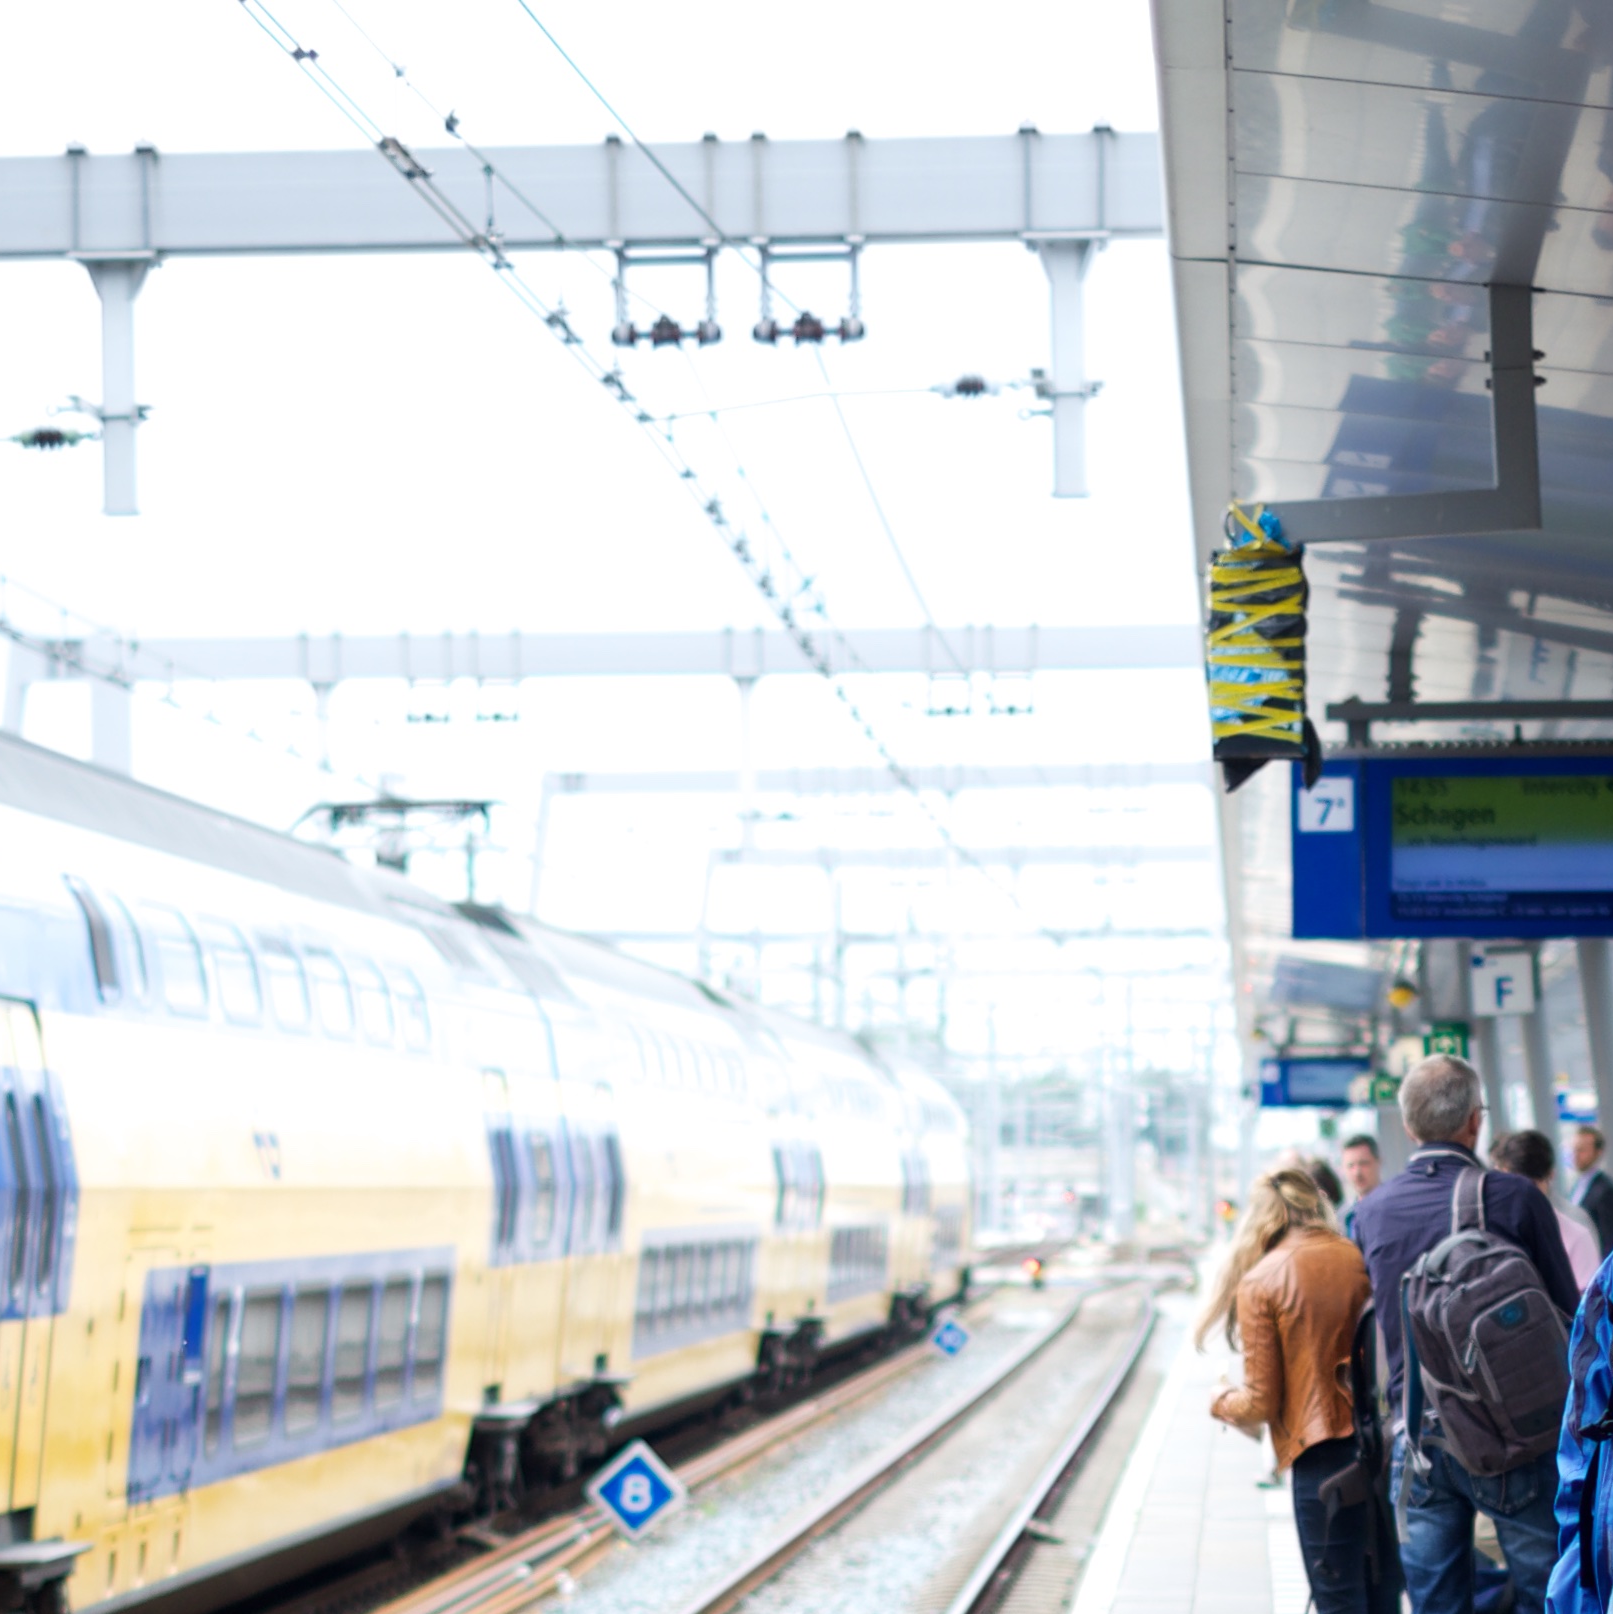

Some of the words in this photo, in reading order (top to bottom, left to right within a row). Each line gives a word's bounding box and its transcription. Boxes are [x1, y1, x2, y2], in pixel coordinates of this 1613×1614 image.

[1395, 803, 1496, 831] Schagen
[1495, 975, 1514, 1008] F
[620, 1473, 652, 1513] 8
